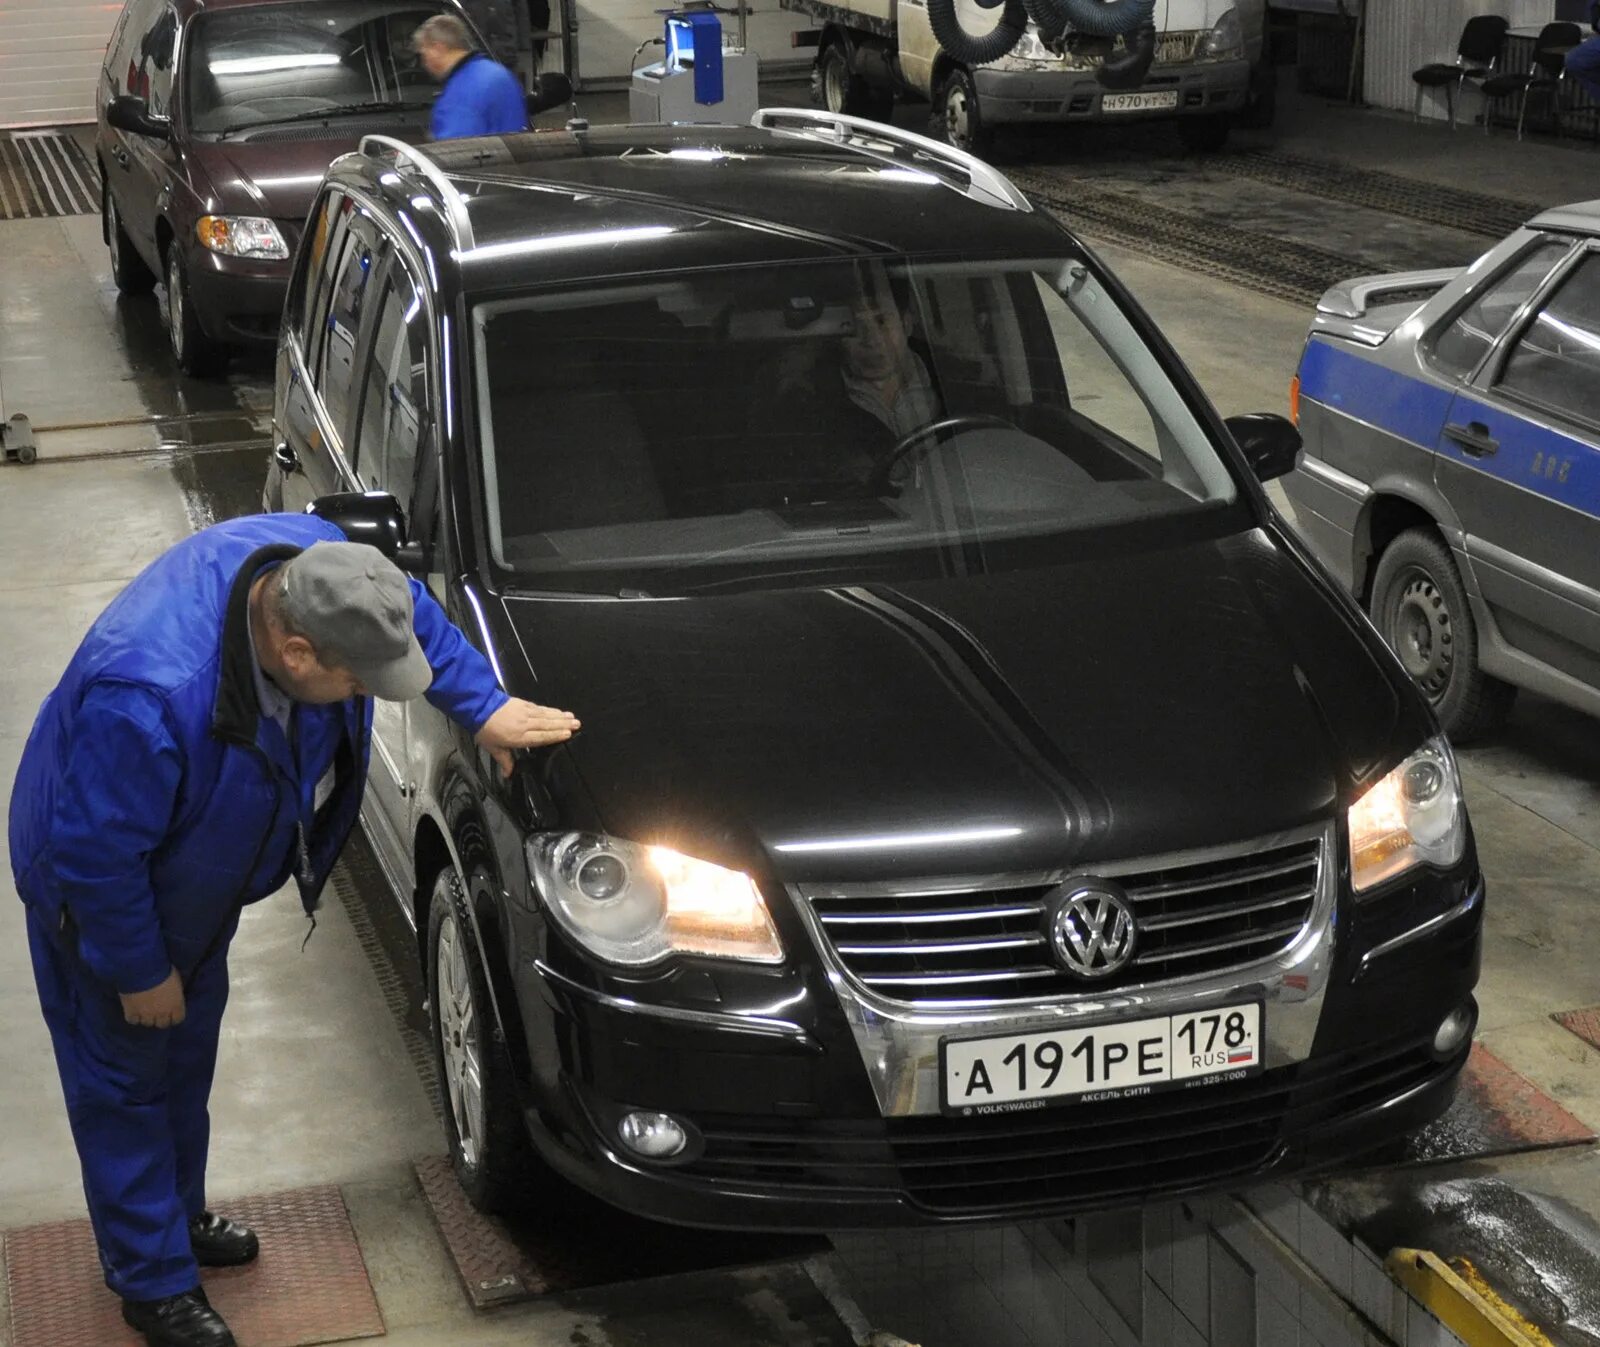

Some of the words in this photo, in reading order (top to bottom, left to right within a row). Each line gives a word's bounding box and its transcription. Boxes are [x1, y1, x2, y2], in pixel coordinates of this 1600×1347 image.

[1177, 1011, 1246, 1055] 178
[964, 1035, 1163, 1097] А191РЕ
[1191, 1051, 1226, 1069] RUS
[976, 1099, 1047, 1115] VOLKSWAGEN
